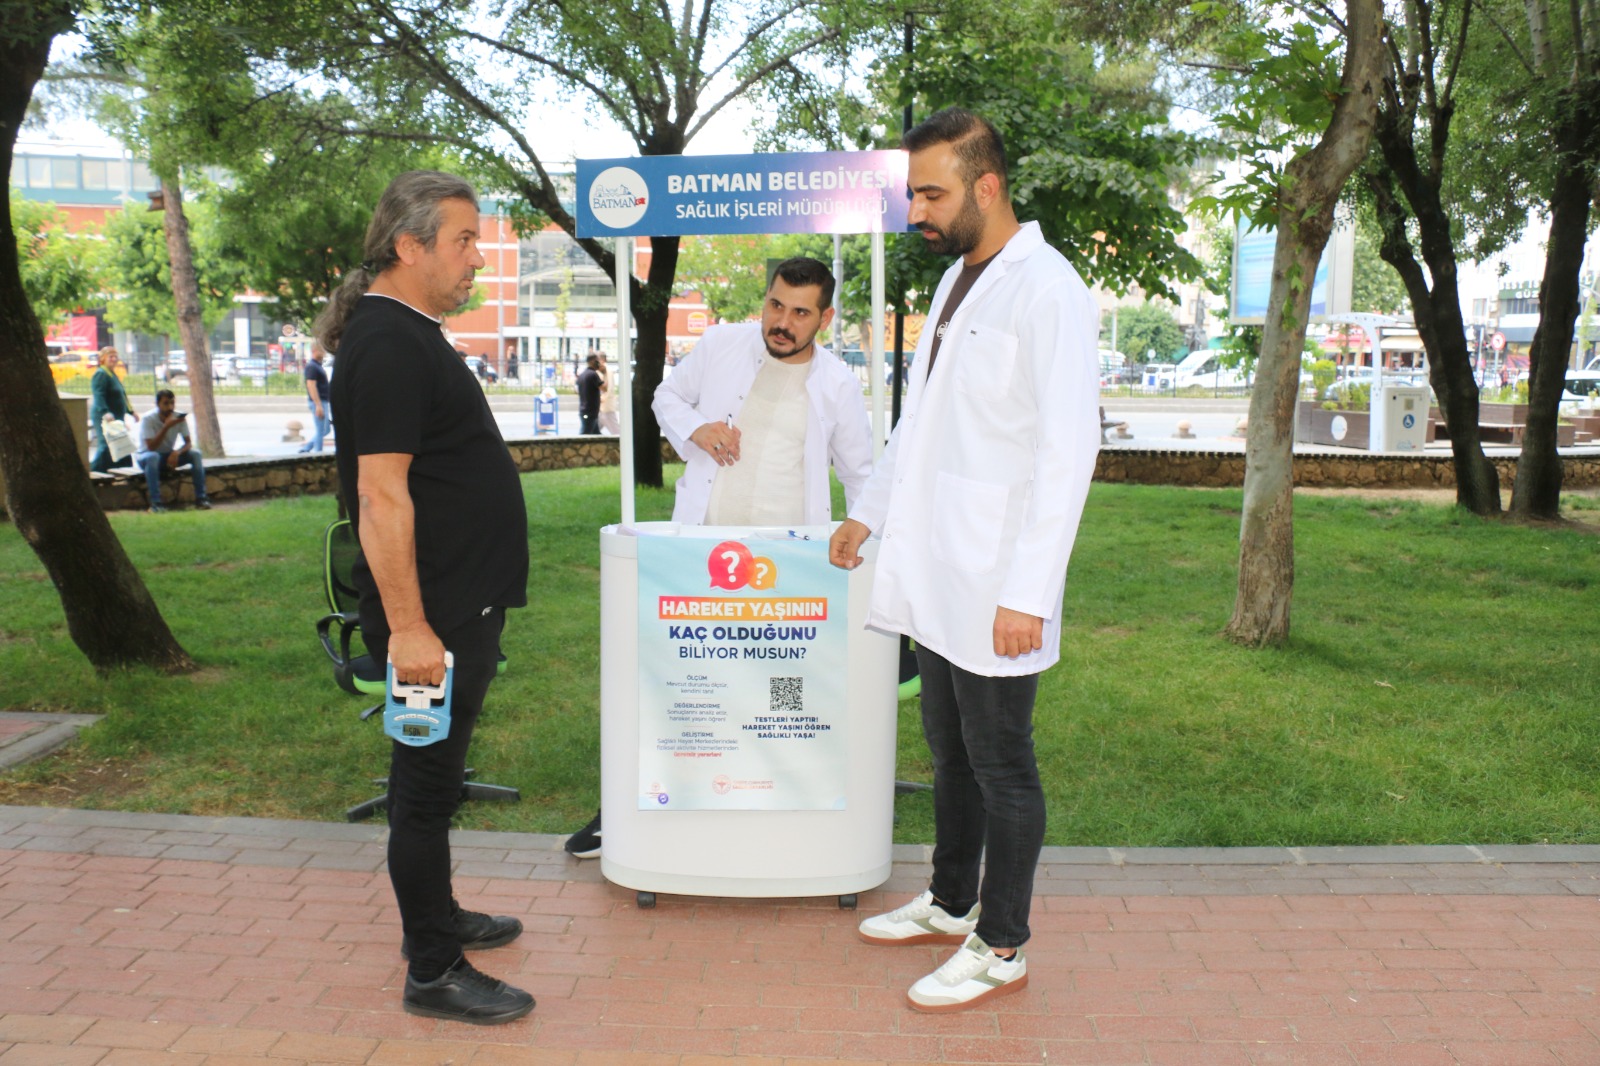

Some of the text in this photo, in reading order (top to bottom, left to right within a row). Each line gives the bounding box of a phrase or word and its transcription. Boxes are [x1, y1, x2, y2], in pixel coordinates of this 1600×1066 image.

[667, 166, 895, 194] BATMAN BELEDİYESİ
[593, 196, 637, 209] BATMAN
[676, 200, 731, 219] SAĞLIK
[734, 198, 783, 220] İŞLERİ
[661, 600, 824, 620] HAREKET YAŞININ
[669, 623, 817, 643] KAÇ OLDUĞUNU
[679, 643, 807, 660] BİLİYOR MUSUN?
[778, 724, 803, 732] YAŞINI
[804, 723, 831, 731] ÖĞREN
[793, 732, 816, 740] YAŞA!
